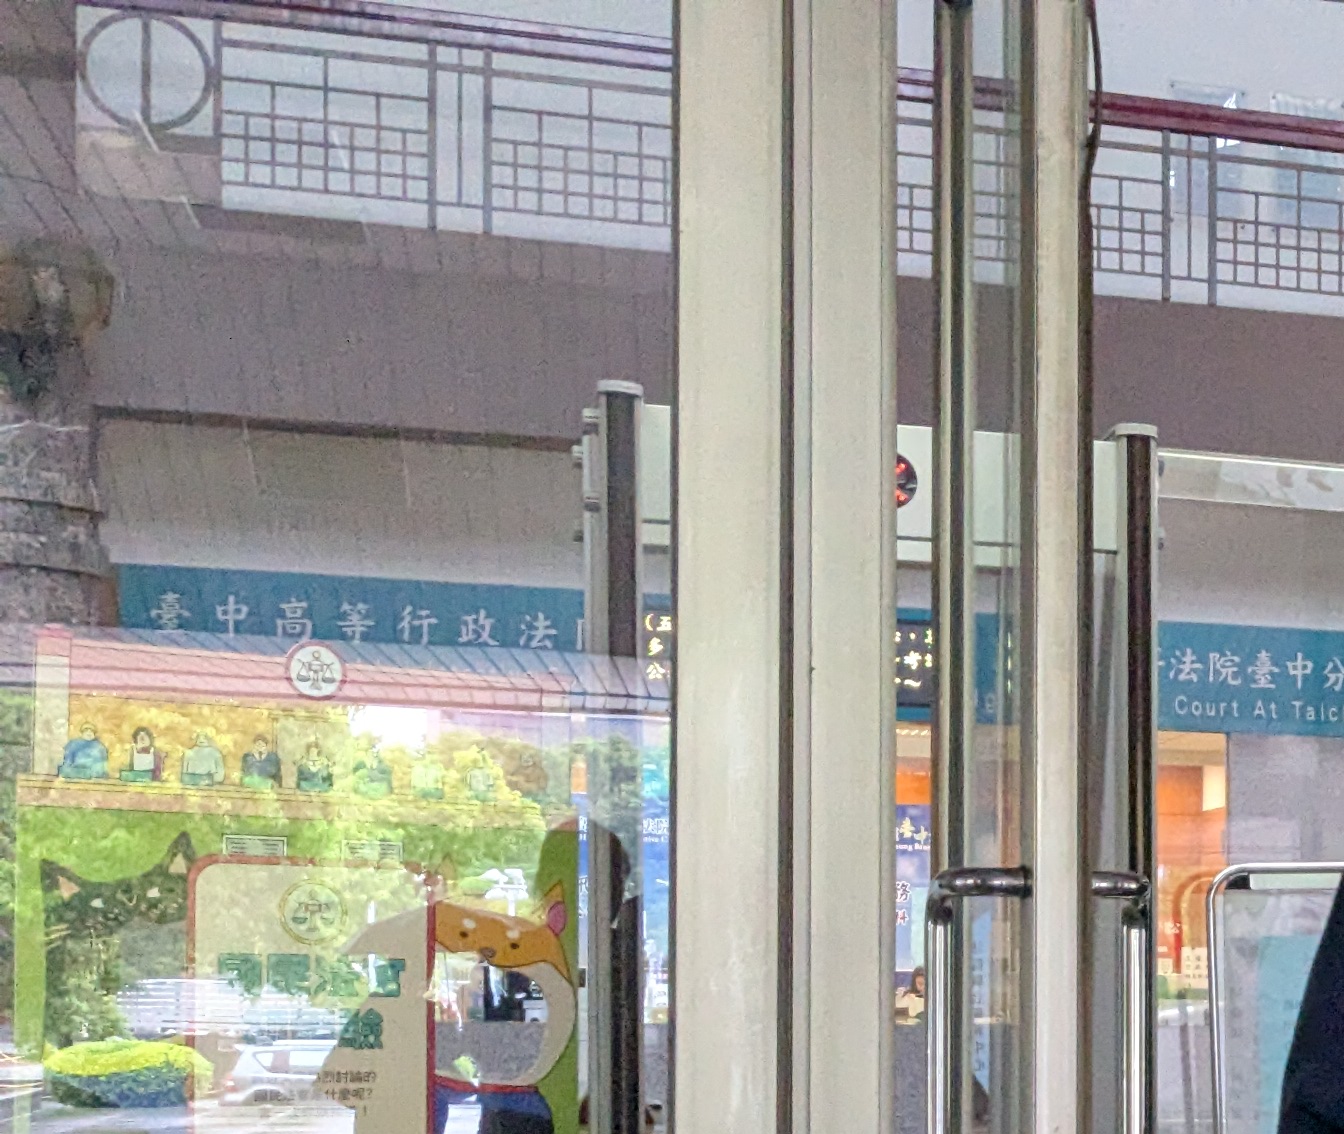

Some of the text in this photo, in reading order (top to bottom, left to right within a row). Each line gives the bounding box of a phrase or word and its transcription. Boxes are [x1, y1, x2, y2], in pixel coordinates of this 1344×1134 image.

[646, 661, 670, 680] 公
[1174, 695, 1240, 718] Court
[1253, 702, 1278, 719] At
